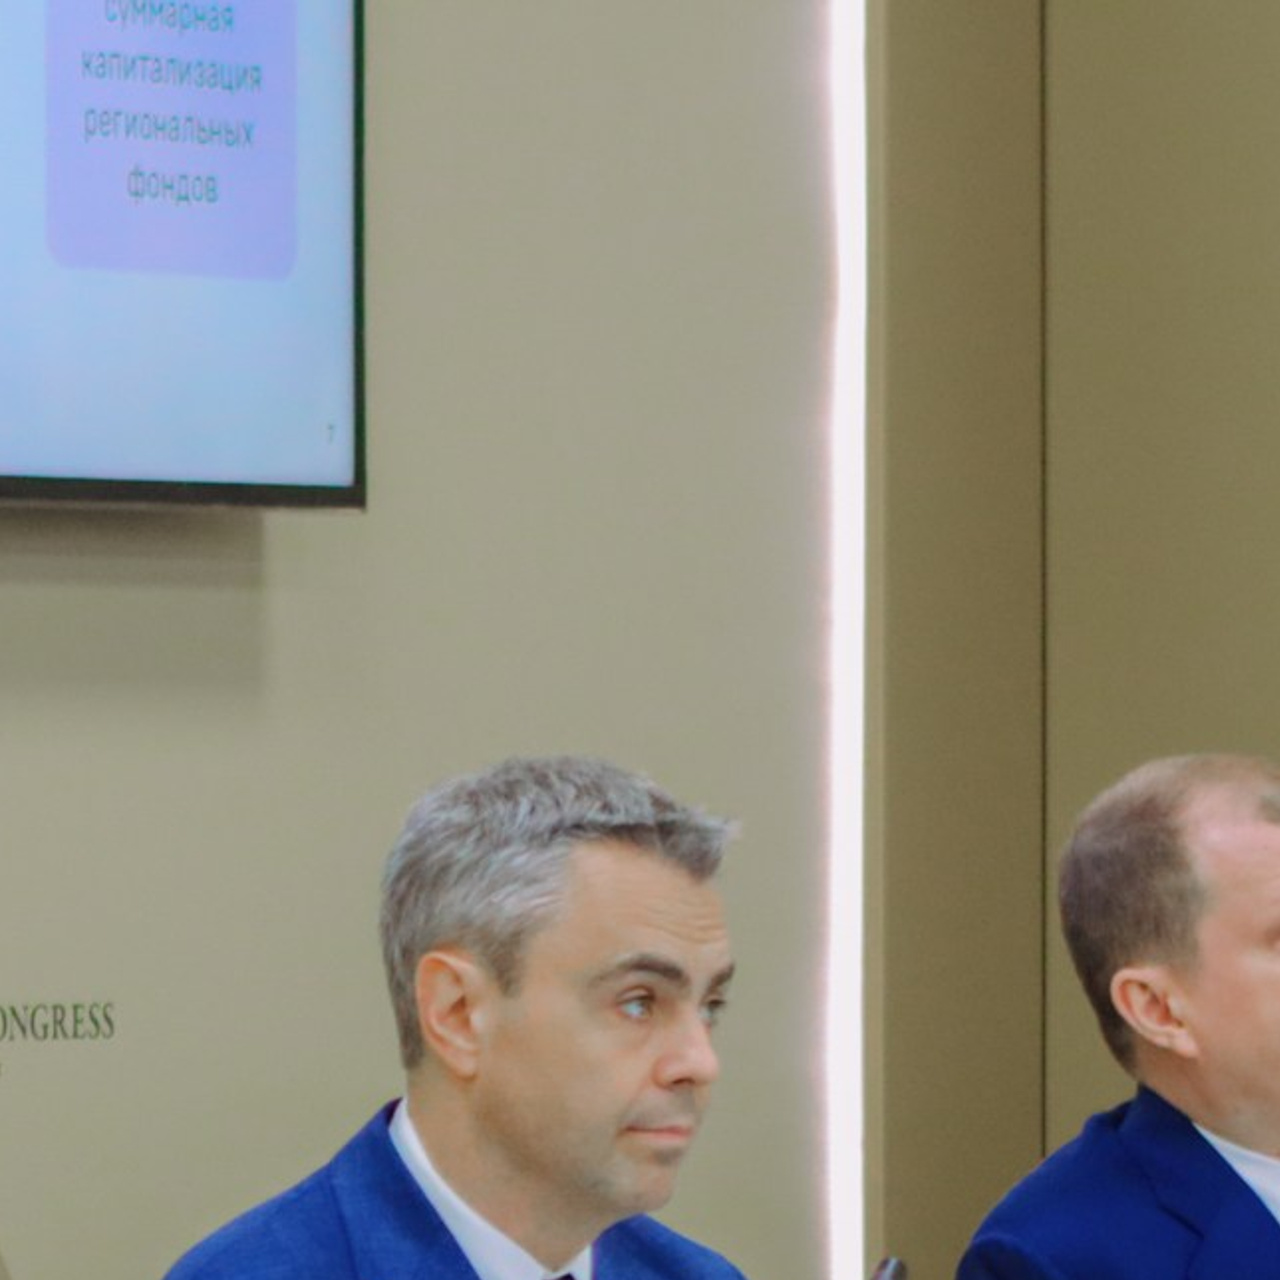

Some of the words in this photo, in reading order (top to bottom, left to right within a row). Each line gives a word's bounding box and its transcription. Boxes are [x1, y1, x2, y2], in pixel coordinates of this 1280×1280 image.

[81, 50, 263, 94] капитализация
[84, 107, 256, 148] региональных
[127, 164, 219, 206] фондов
